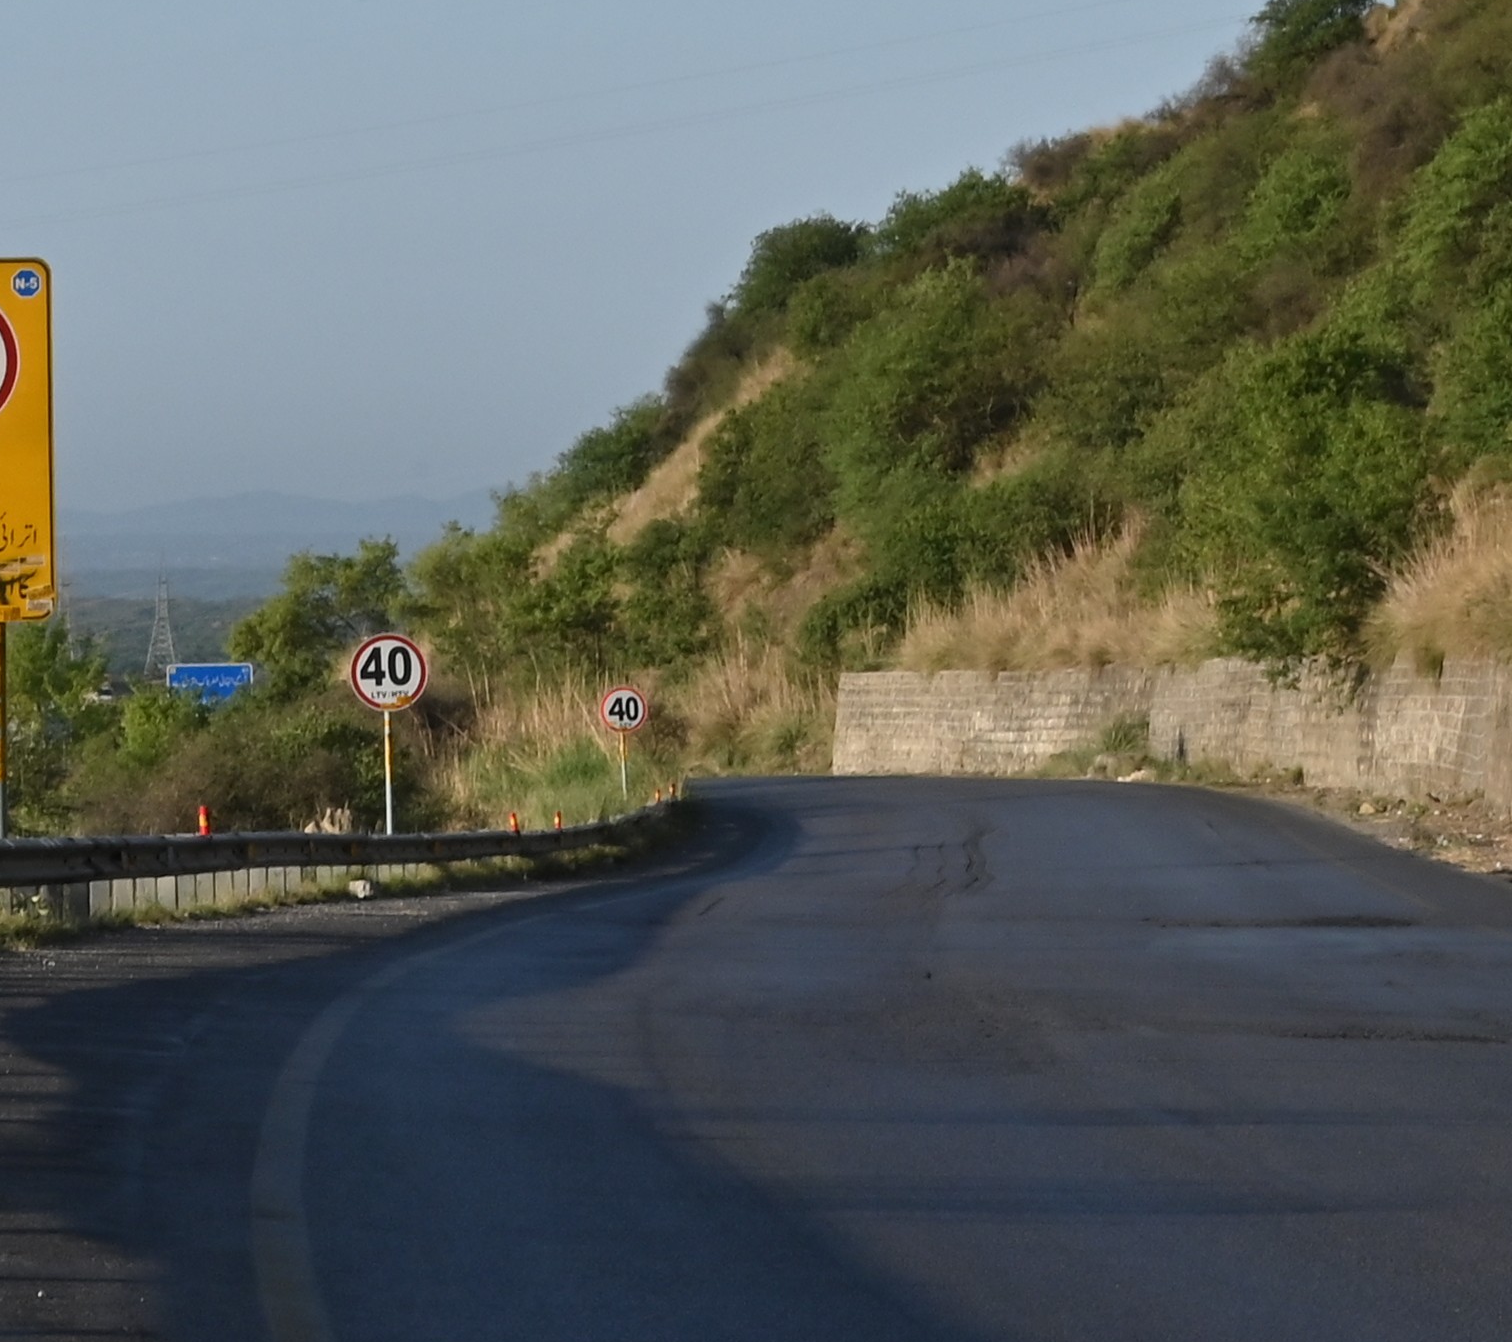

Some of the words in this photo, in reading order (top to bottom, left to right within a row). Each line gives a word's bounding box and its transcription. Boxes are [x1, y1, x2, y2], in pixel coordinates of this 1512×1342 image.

[15, 276, 38, 290] N-5
[360, 646, 412, 686] 40
[609, 696, 639, 721] 40
